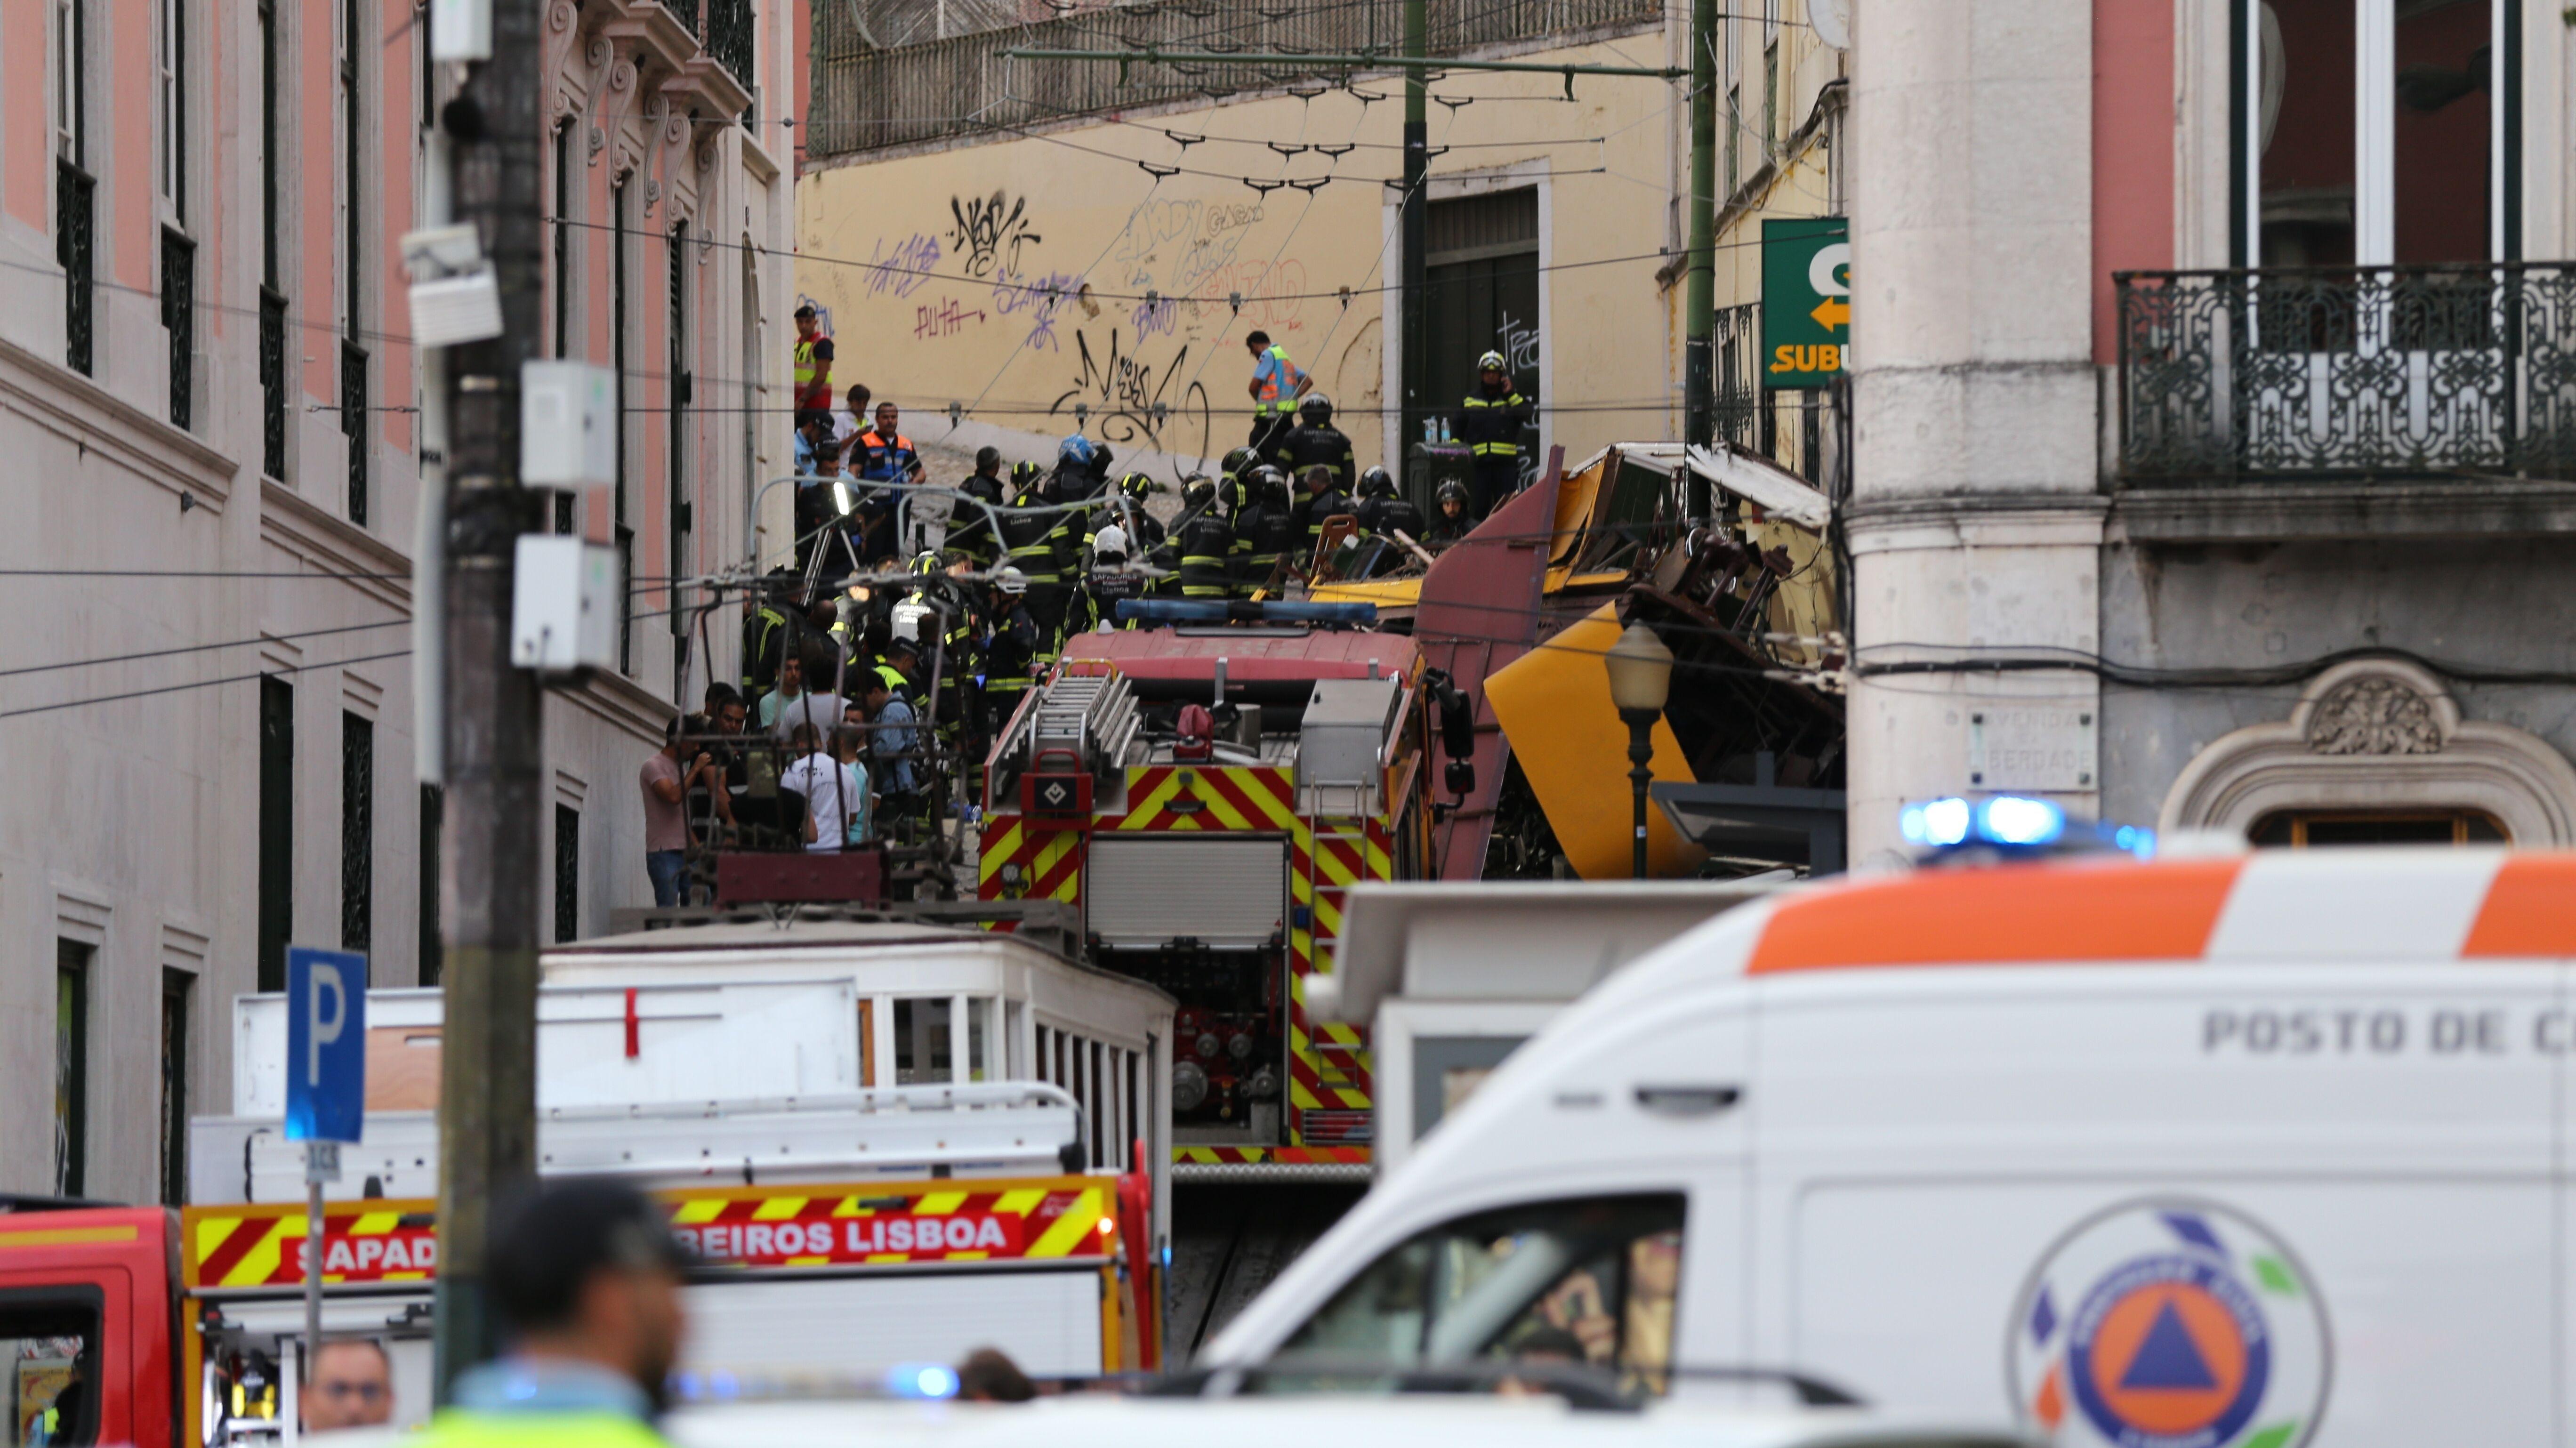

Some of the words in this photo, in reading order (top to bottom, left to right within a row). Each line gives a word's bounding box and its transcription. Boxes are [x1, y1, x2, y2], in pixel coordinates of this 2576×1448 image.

[309, 963, 346, 1087] P
[2202, 1011, 2407, 1054] POSTO
[2432, 1011, 2509, 1054] DE
[2535, 1011, 2576, 1054] C
[846, 1217, 1006, 1253] LISBOA
